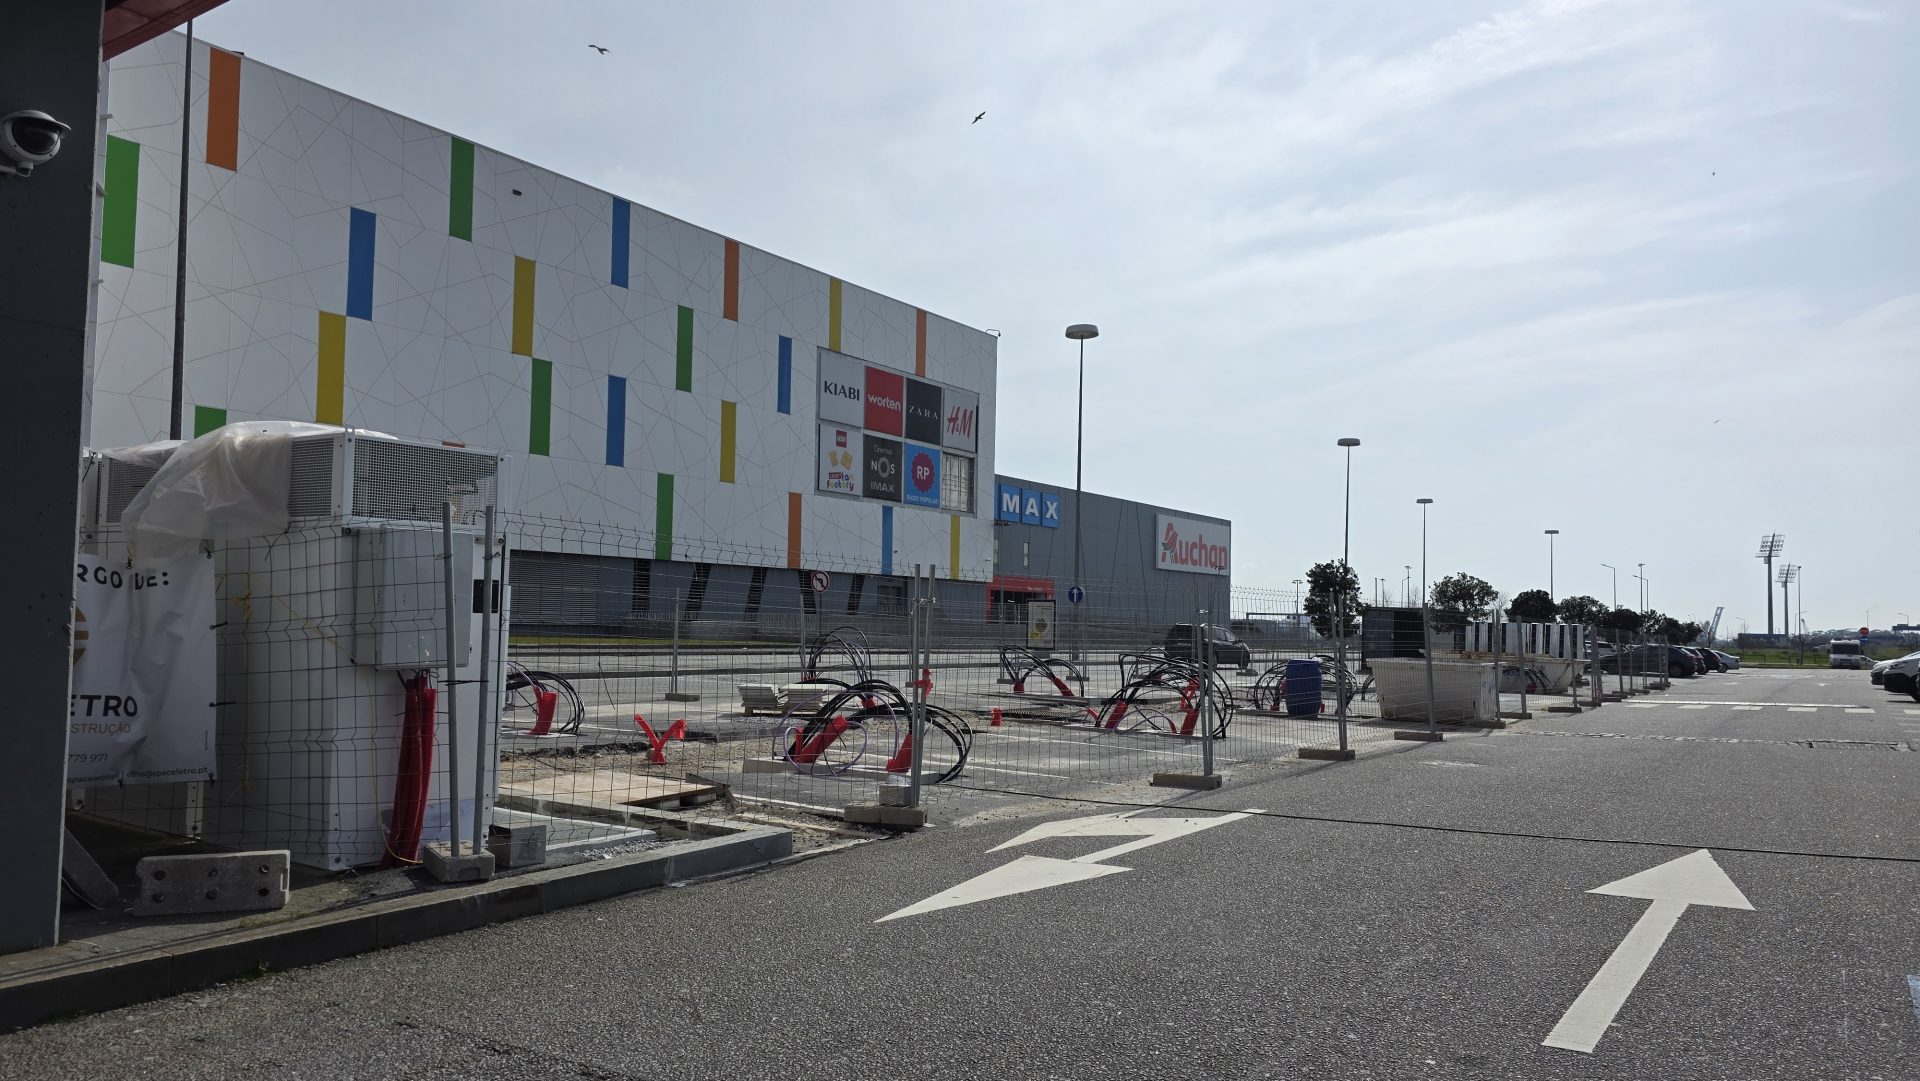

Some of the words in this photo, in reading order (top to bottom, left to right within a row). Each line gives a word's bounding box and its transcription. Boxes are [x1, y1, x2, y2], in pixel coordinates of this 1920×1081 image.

[824, 381, 860, 401] KIABI
[868, 394, 901, 412] worten
[909, 405, 939, 420] ZARA
[947, 405, 974, 440] H&M
[871, 457, 896, 478] NOS
[916, 466, 930, 480] RP
[870, 481, 895, 493] IMAX
[1002, 492, 1059, 520] MAX
[1161, 522, 1228, 570] Auchan
[90, 753, 108, 763] 971
